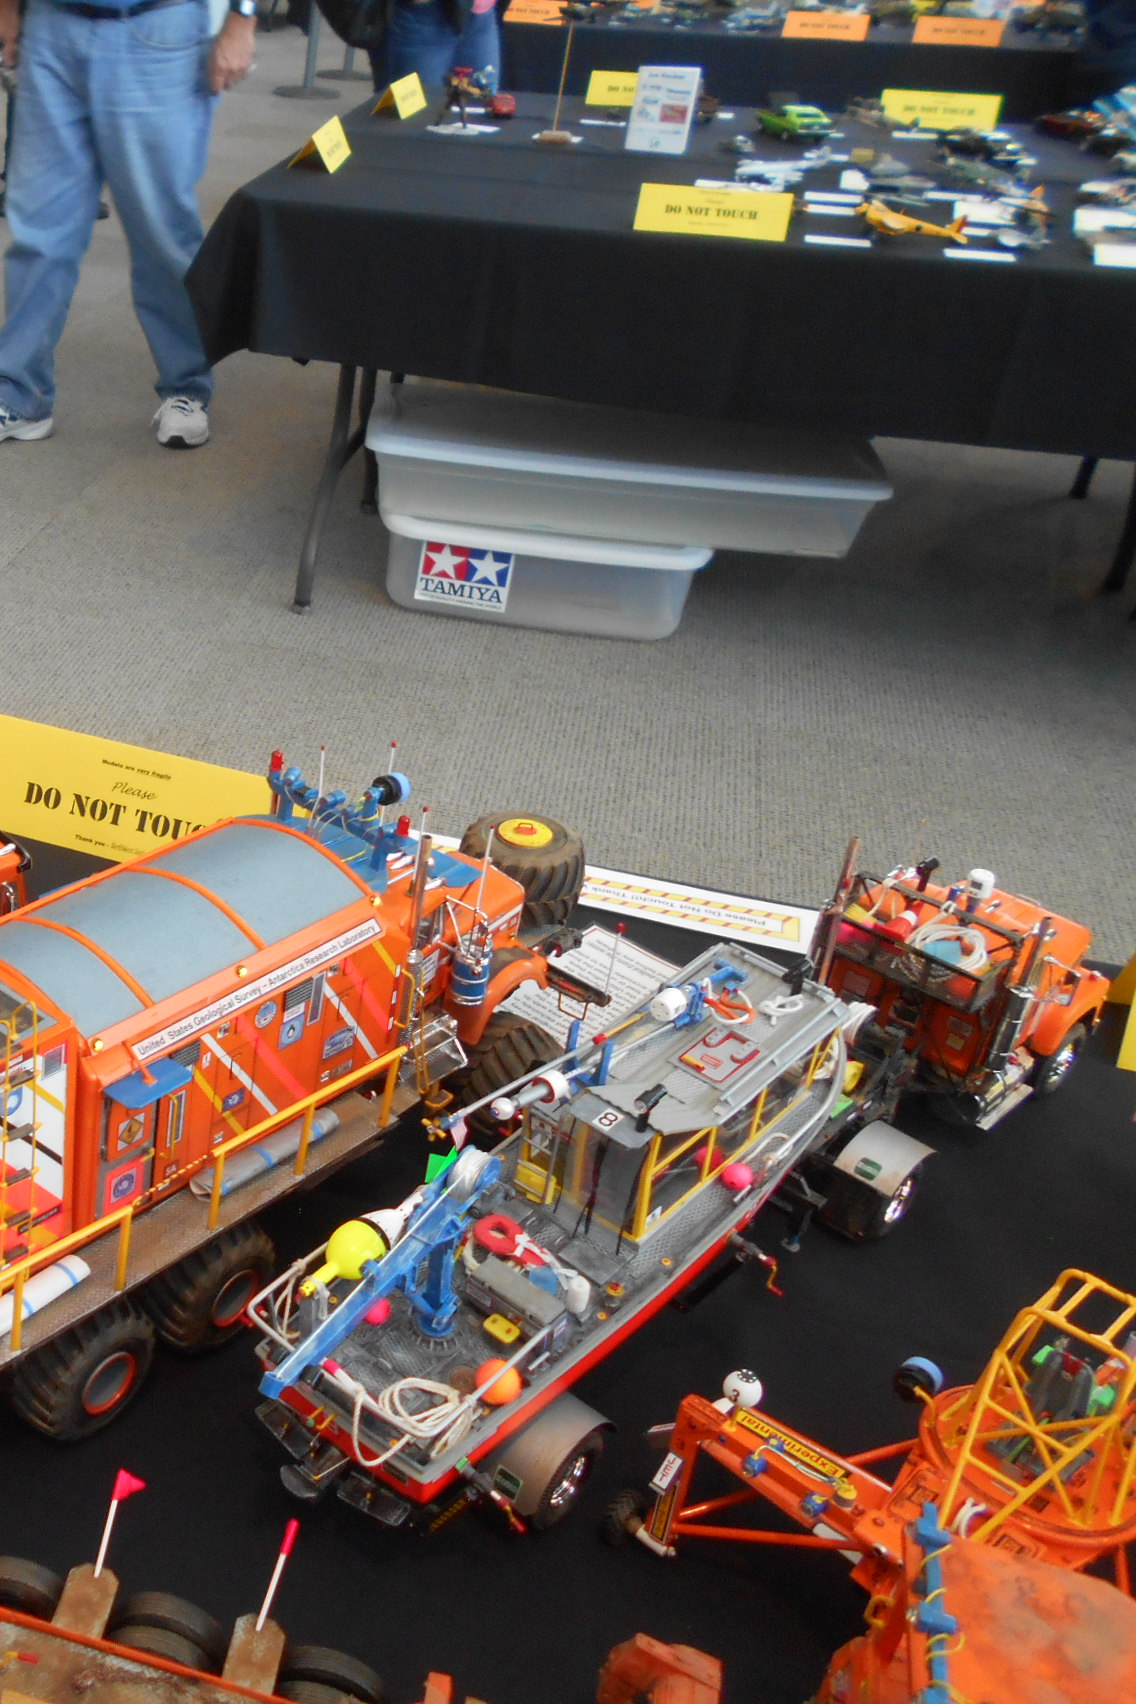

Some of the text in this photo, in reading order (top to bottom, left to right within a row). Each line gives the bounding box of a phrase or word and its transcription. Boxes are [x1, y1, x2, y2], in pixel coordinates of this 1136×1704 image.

[664, 204, 758, 220] DO NOT TOUCH
[419, 576, 503, 603] TAMIYA
[112, 781, 158, 800] Please
[24, 782, 62, 810] DO
[69, 792, 127, 826] NOT
[74, 834, 106, 848] Thank you
[591, 885, 626, 898] Thank
[679, 903, 700, 912] Not
[704, 908, 721, 917] Do
[724, 912, 766, 926] Please
[136, 1034, 166, 1056] United
[166, 1019, 193, 1040] States
[191, 997, 236, 1027] Geological
[232, 982, 262, 1005] Survey
[266, 960, 305, 987] Antarctica
[303, 942, 339, 967] Research
[336, 922, 376, 949] Laboratory
[598, 1112, 618, 1128] 8
